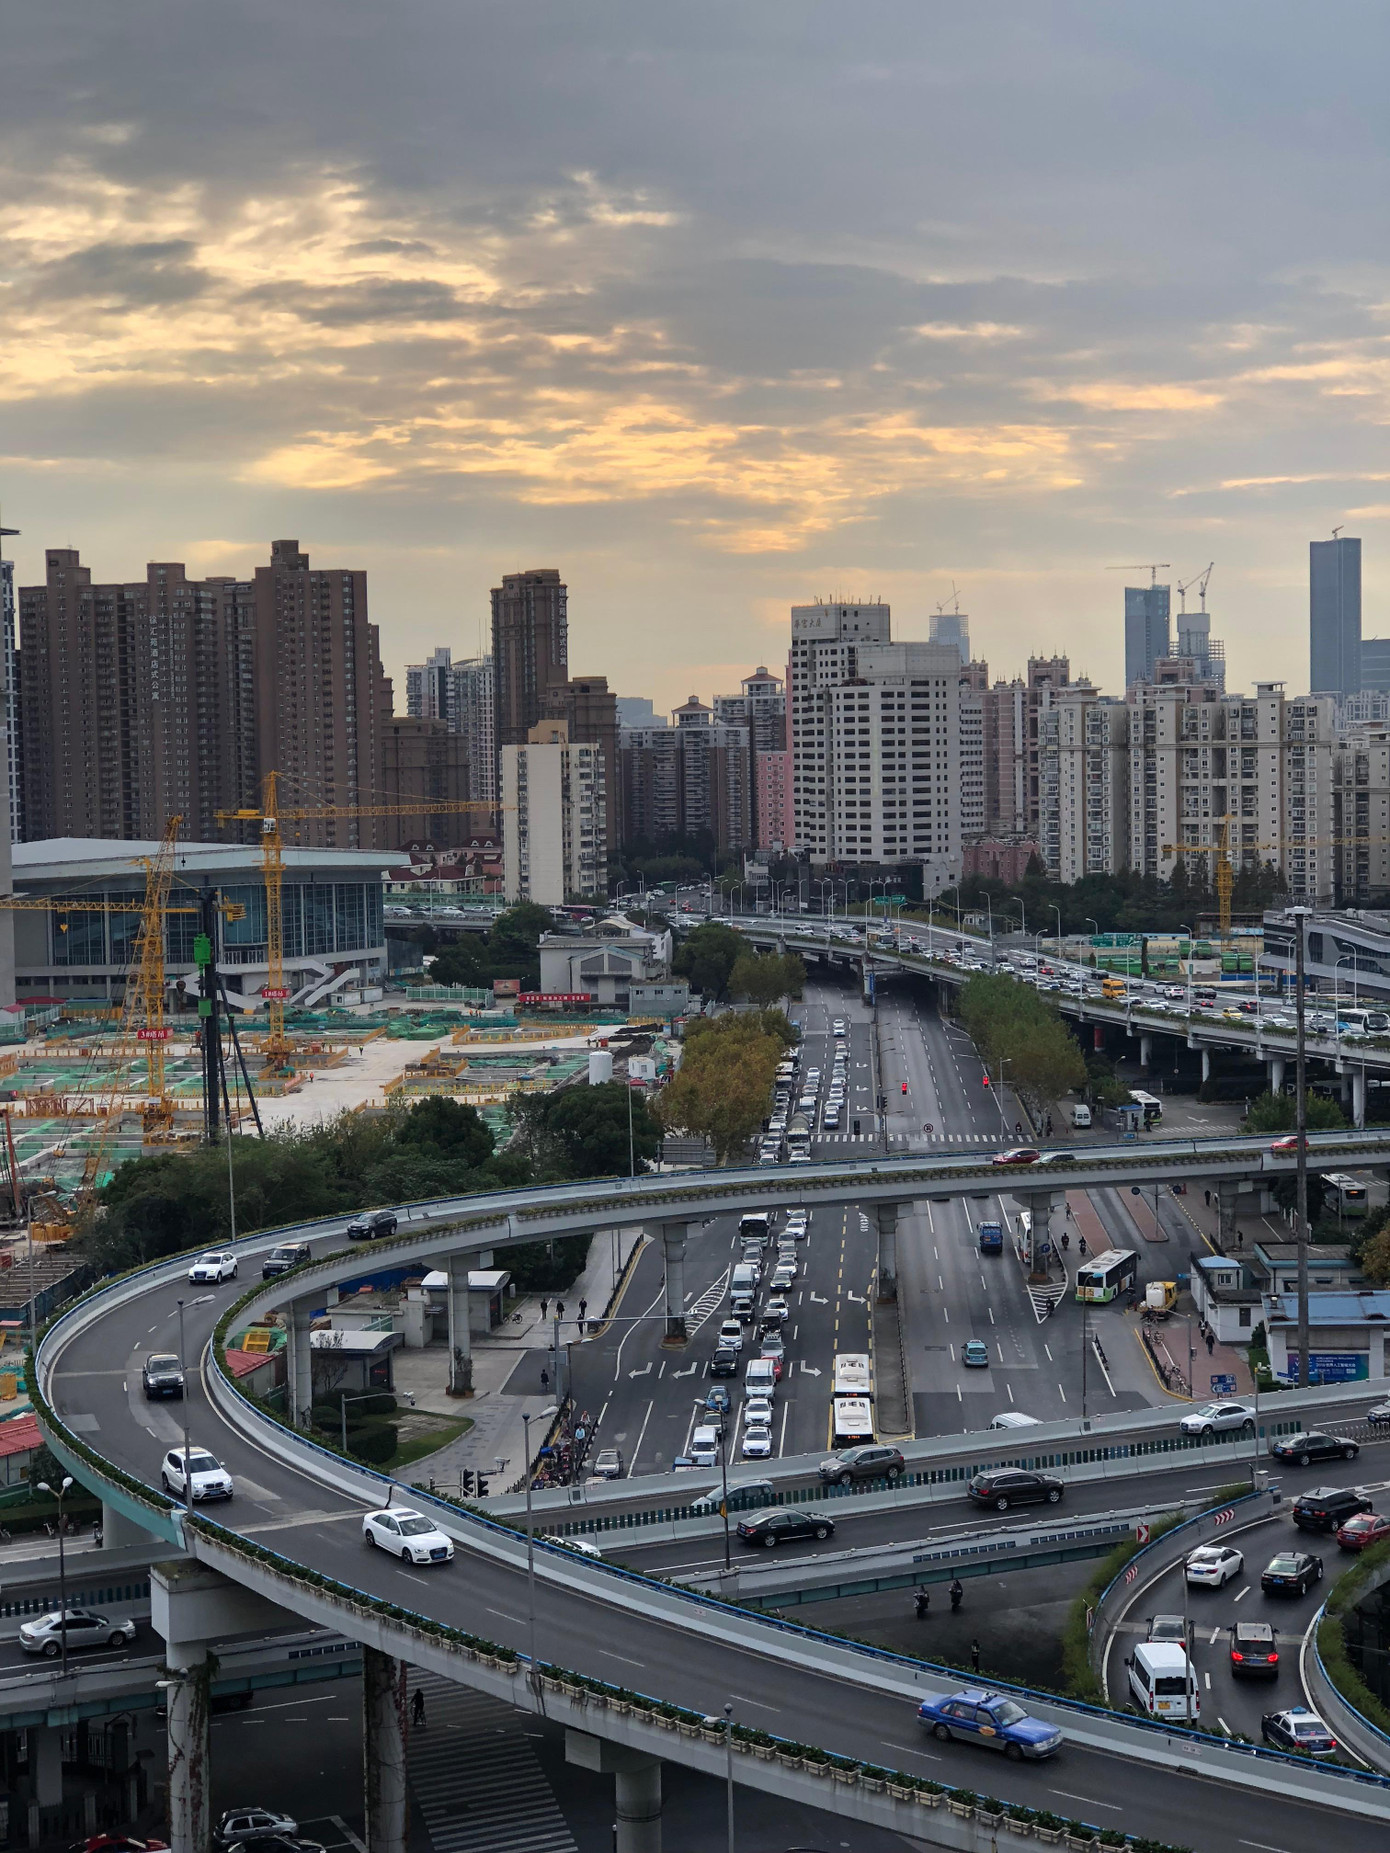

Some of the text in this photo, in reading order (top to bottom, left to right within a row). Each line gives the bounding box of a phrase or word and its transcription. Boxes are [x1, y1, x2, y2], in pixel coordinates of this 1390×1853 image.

[149, 615, 159, 700] 徐汇苑酒店式公寓
[558, 588, 567, 665] 徐汇苑酒店式公寓
